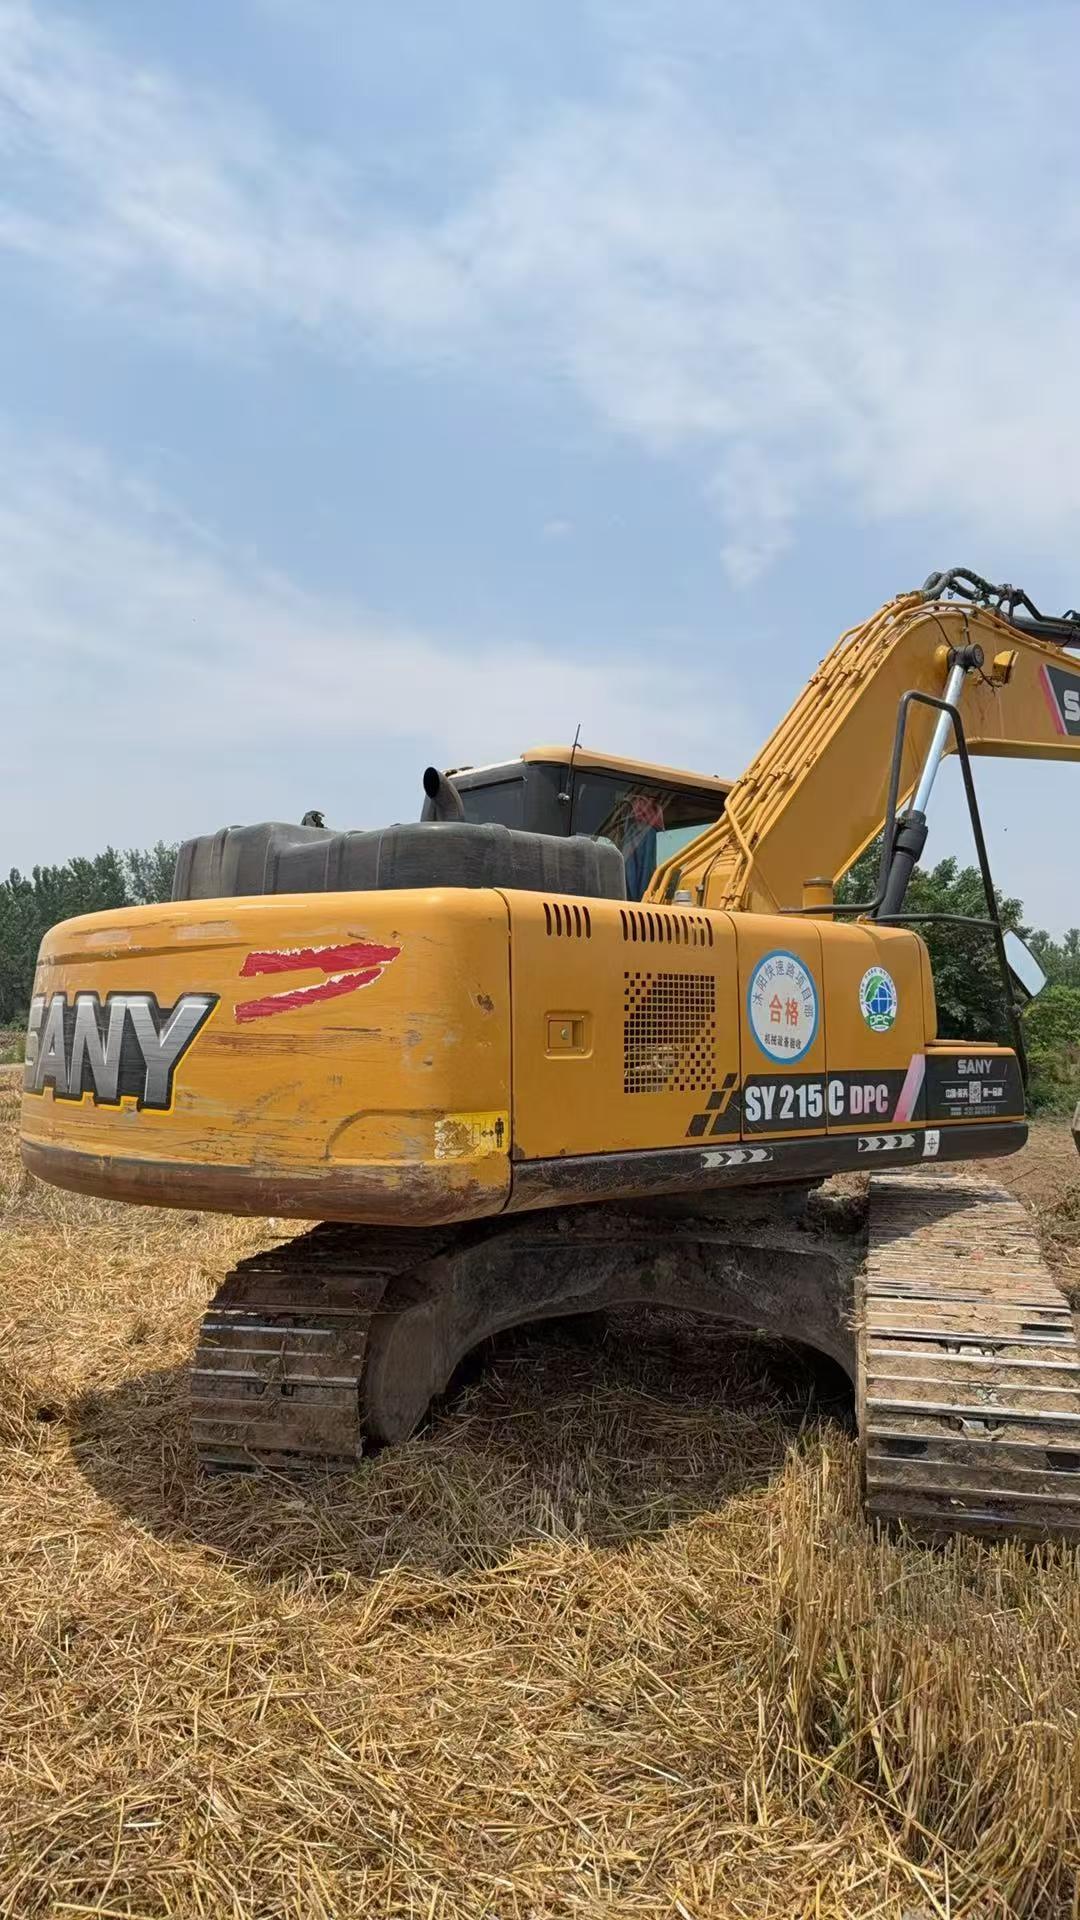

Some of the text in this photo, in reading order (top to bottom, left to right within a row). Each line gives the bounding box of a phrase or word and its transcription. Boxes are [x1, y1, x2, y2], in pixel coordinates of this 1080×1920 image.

[769, 993, 799, 1027] 合格
[870, 1015, 891, 1025] DPC
[764, 1033, 802, 1050] 机械设备验收
[957, 1059, 993, 1074] SANY
[850, 1084, 889, 1115] DPC
